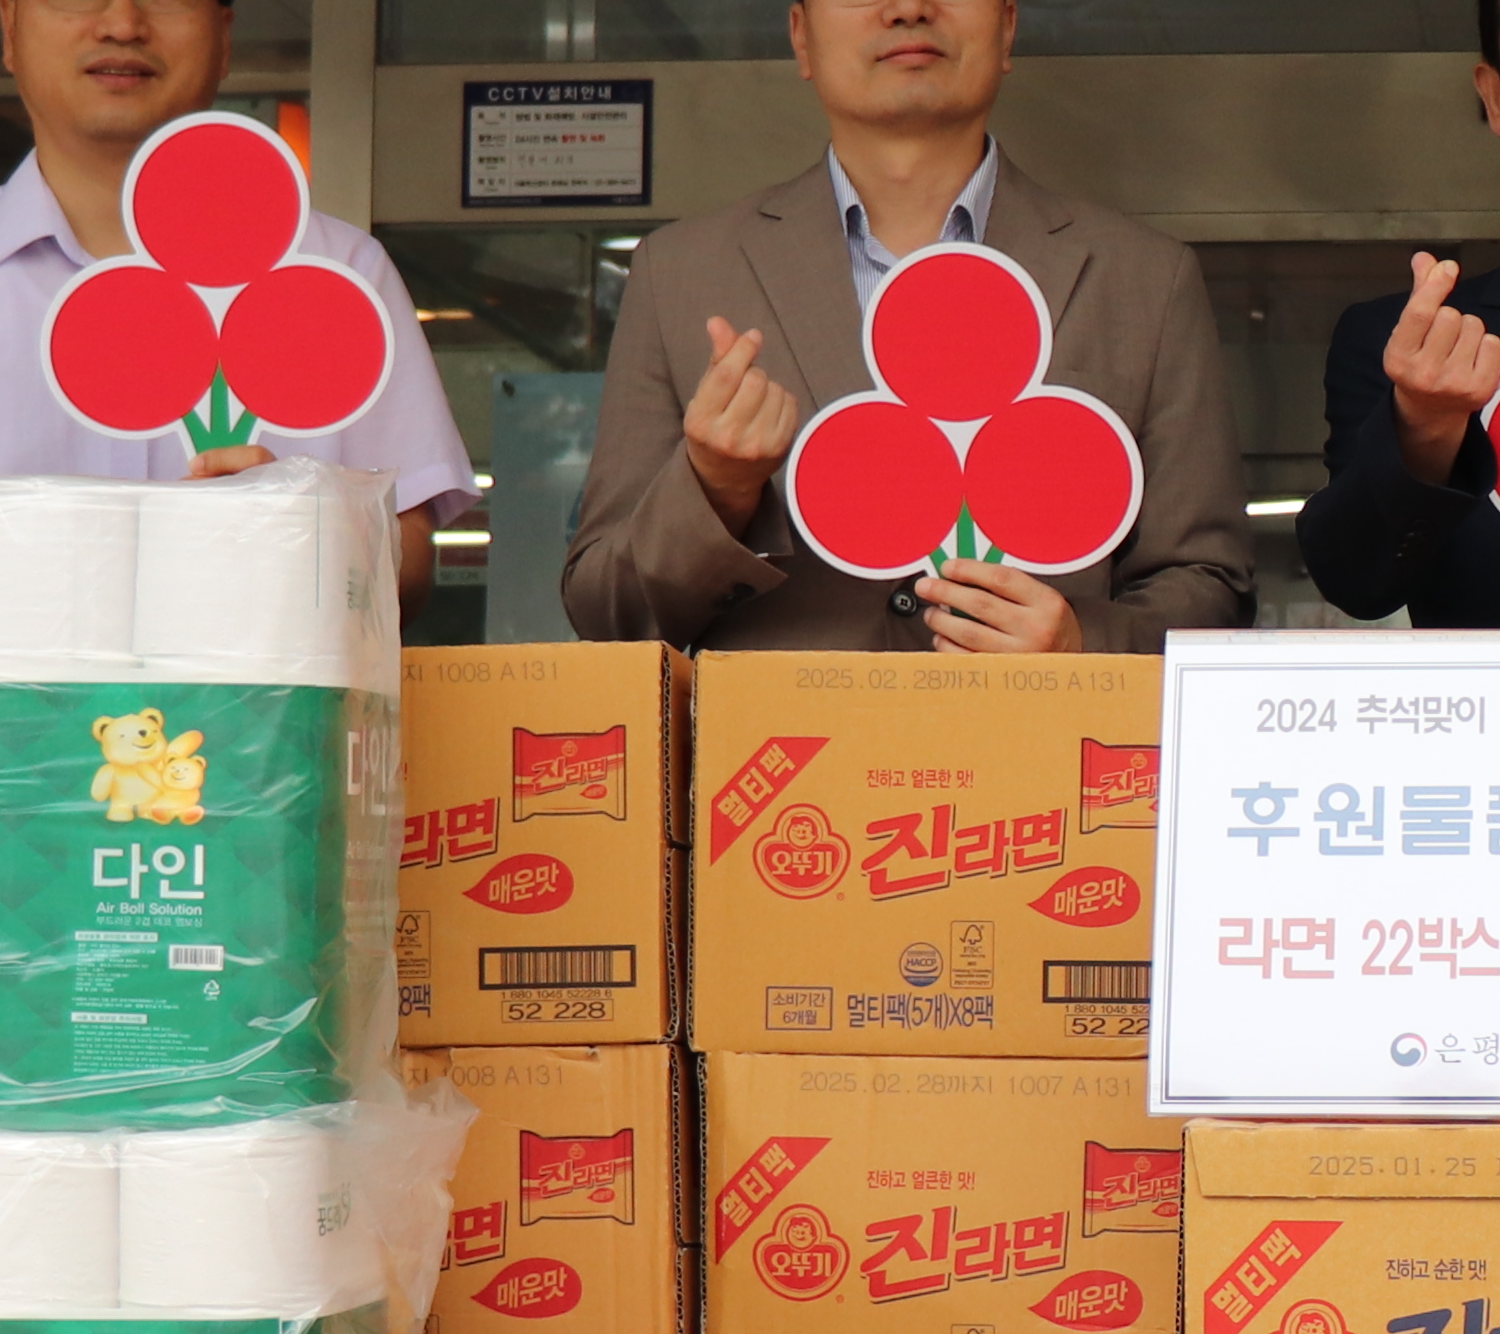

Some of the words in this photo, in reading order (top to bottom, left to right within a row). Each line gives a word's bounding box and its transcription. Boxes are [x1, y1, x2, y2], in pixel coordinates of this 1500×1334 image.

[488, 86, 612, 102] CCTV설치안내
[438, 662, 491, 683] 1008
[1001, 670, 1058, 692] 1005
[1256, 698, 1338, 733] 2024
[1356, 694, 1487, 735] 추석맞이
[531, 756, 609, 795] 진라면
[717, 742, 796, 826] 멀티팩
[867, 769, 906, 788] 진하고
[911, 769, 952, 788] 얼큰한
[957, 769, 974, 789] 맛!
[400, 797, 500, 867] 라면
[771, 850, 834, 877] 오뚜기
[861, 803, 1068, 901] 진라면
[93, 843, 205, 900] 다인
[488, 863, 560, 905] 매운맛
[96, 901, 116, 915] Air
[149, 902, 203, 916] Solution
[1054, 876, 1127, 917] 매운맛
[906, 957, 937, 967] HACCP
[1217, 917, 1337, 980] 라면
[508, 1003, 542, 1021] 52
[554, 1001, 606, 1019] 228
[773, 993, 826, 1008] 소비기간
[782, 1010, 818, 1026] 6개월
[1071, 1017, 1106, 1035] 52
[1008, 1075, 1061, 1097] 1007
[538, 1159, 616, 1199] 진라면
[717, 1143, 796, 1228] 멀티팩
[867, 1170, 906, 1190] 진하고
[912, 1170, 953, 1190] 얼큰한
[958, 1171, 976, 1190] 맛!
[771, 1251, 833, 1277] 오뚜기
[860, 1205, 1069, 1305] 진라면
[1386, 1259, 1430, 1281] 진하고
[1433, 1259, 1466, 1281] 순한
[1469, 1260, 1488, 1281] 맛!
[497, 1267, 568, 1309] 매운맛
[1211, 1227, 1303, 1324] 멀티팩
[1055, 1280, 1128, 1320] 매운맛
